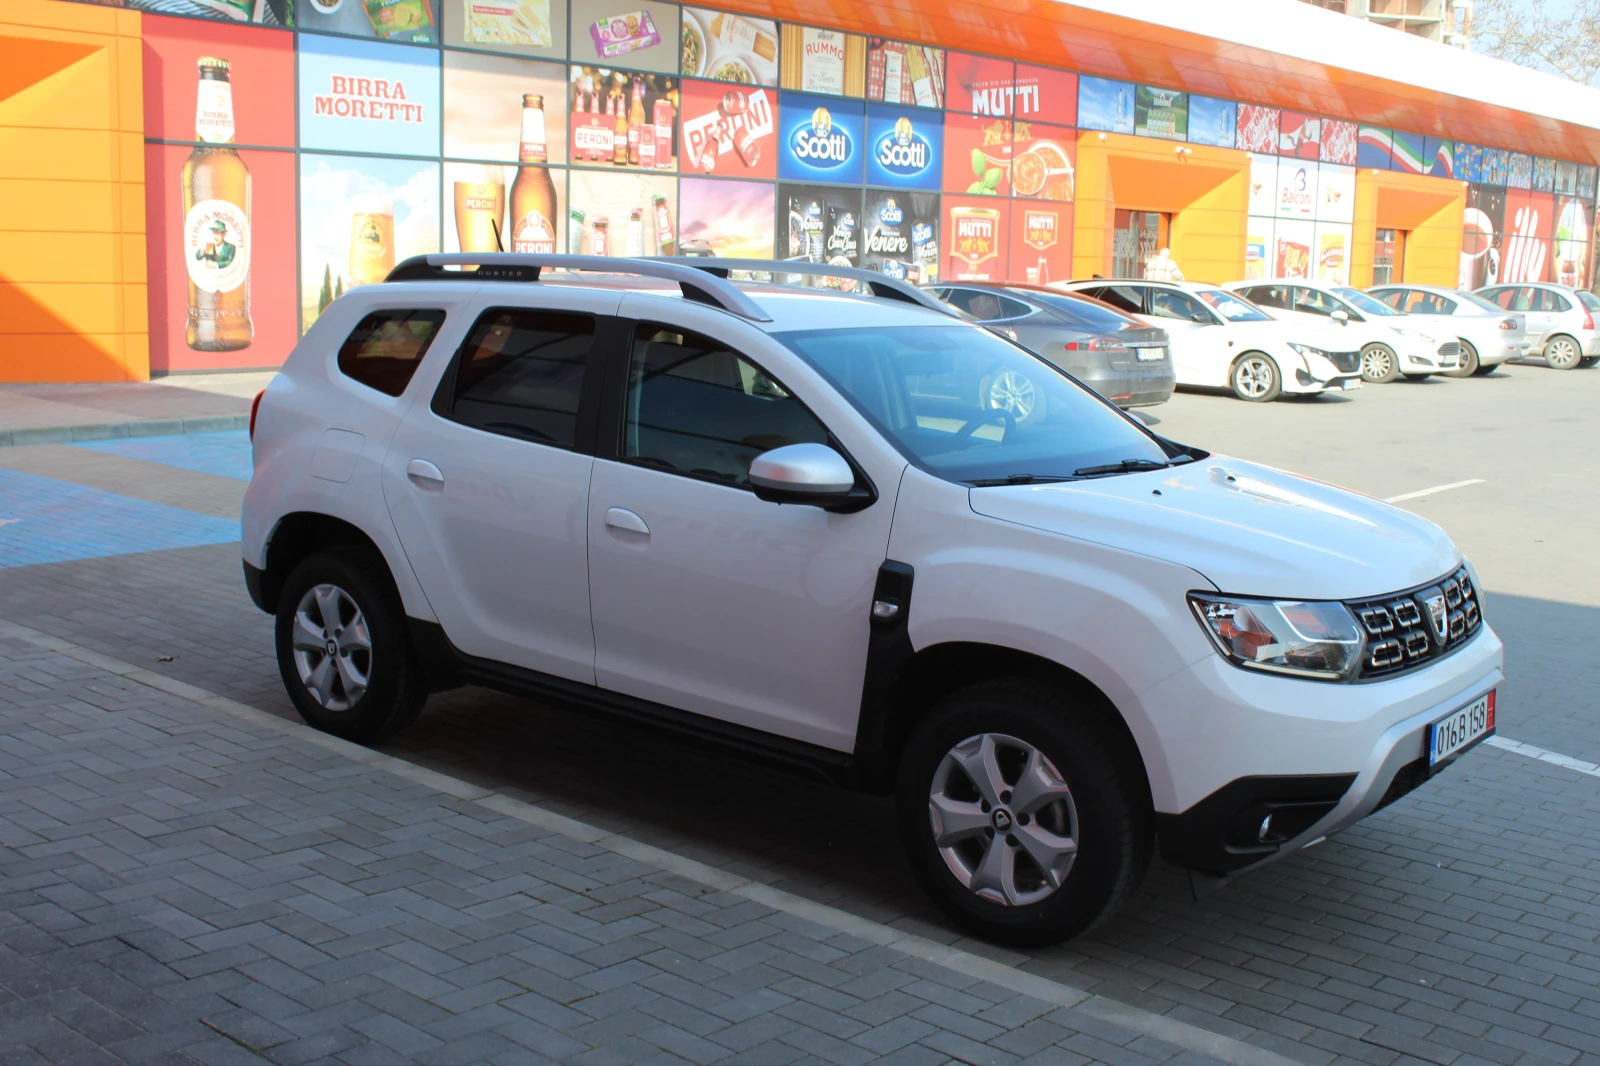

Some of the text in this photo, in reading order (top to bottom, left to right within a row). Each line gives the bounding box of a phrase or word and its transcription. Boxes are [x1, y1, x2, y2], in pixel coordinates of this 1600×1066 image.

[806, 42, 844, 60] RUMMO
[332, 76, 406, 100] BIRRA
[314, 97, 422, 122] MORETTI
[972, 85, 1040, 119] MUTTI
[577, 133, 612, 145] PERONI
[796, 131, 846, 161] Scotti
[880, 140, 925, 168] Scotti
[466, 198, 495, 210] PERONI
[1282, 188, 1312, 204] Balconi
[881, 209, 902, 222] Scotti
[1029, 217, 1053, 230] MUTTI
[192, 212, 244, 248] BIRRA MORETTI
[864, 225, 908, 254] Venere
[958, 222, 992, 238] MUTTI
[515, 242, 553, 254] PERONI
[1437, 718, 1457, 756] 016
[1469, 701, 1485, 736] 158
